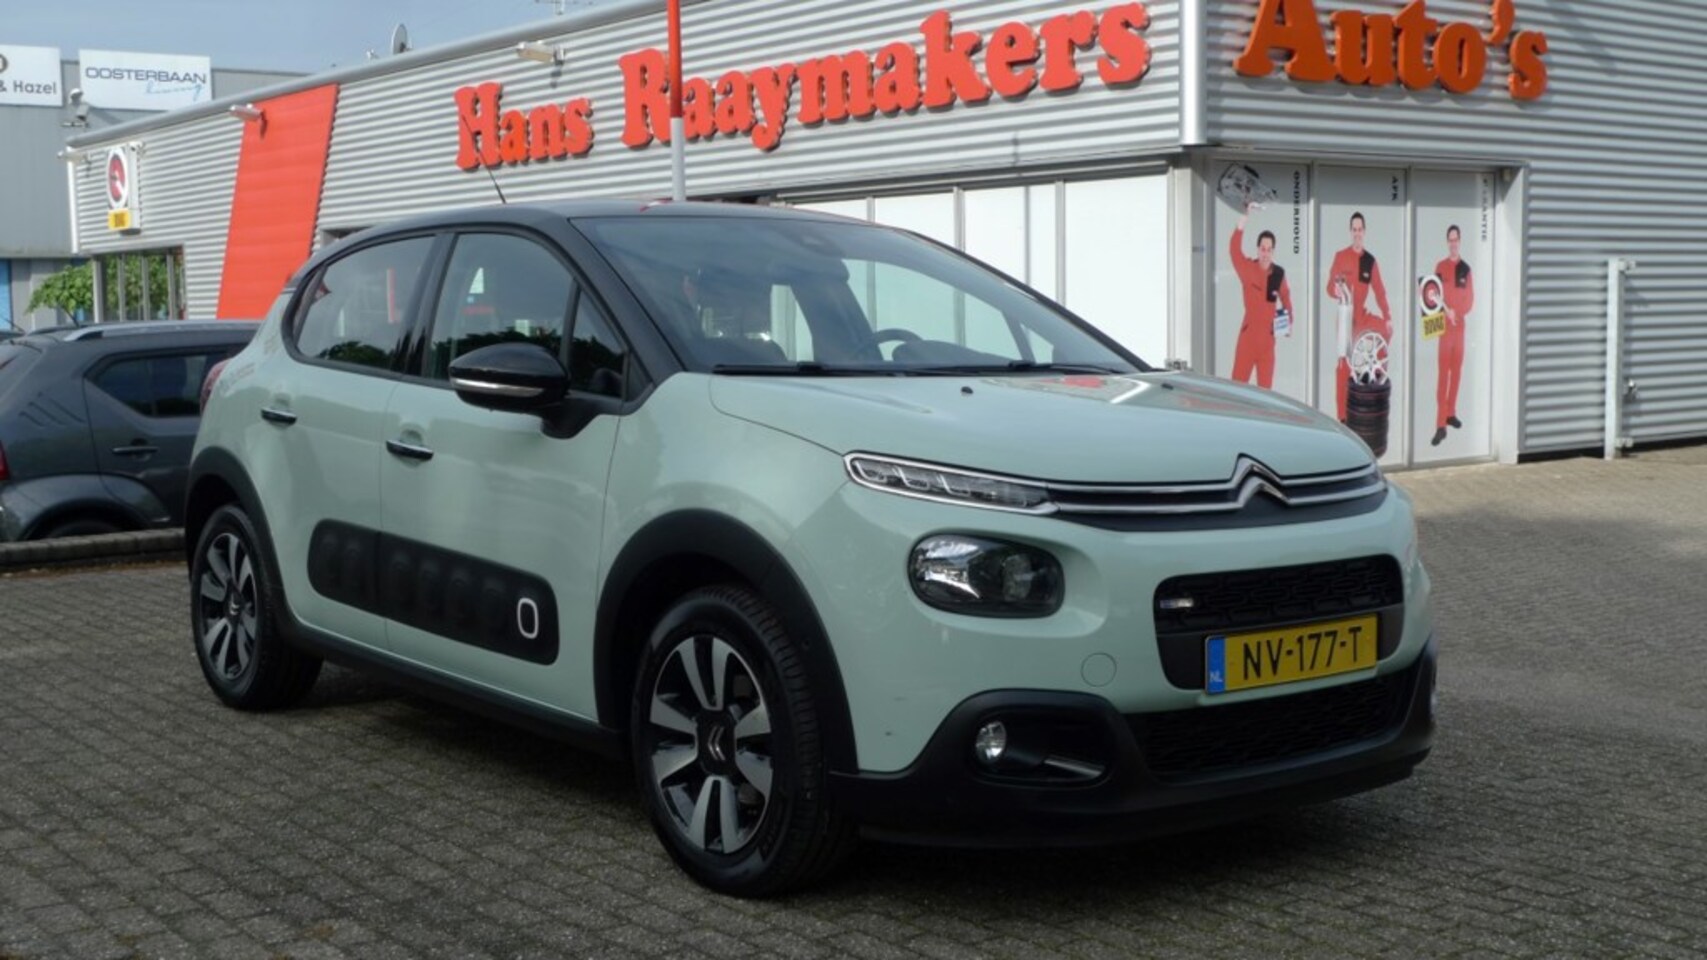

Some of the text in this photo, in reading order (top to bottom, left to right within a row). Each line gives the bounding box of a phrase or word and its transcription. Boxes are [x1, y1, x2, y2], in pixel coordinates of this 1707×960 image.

[1233, 0, 1548, 99] Auto's
[13, 80, 57, 94] Hazel
[85, 67, 206, 84] OOSTERBAAN
[454, 3, 1151, 169] Hans Raaymakers
[1243, 626, 1362, 680] NV-177-T
[1209, 671, 1223, 682] NL
